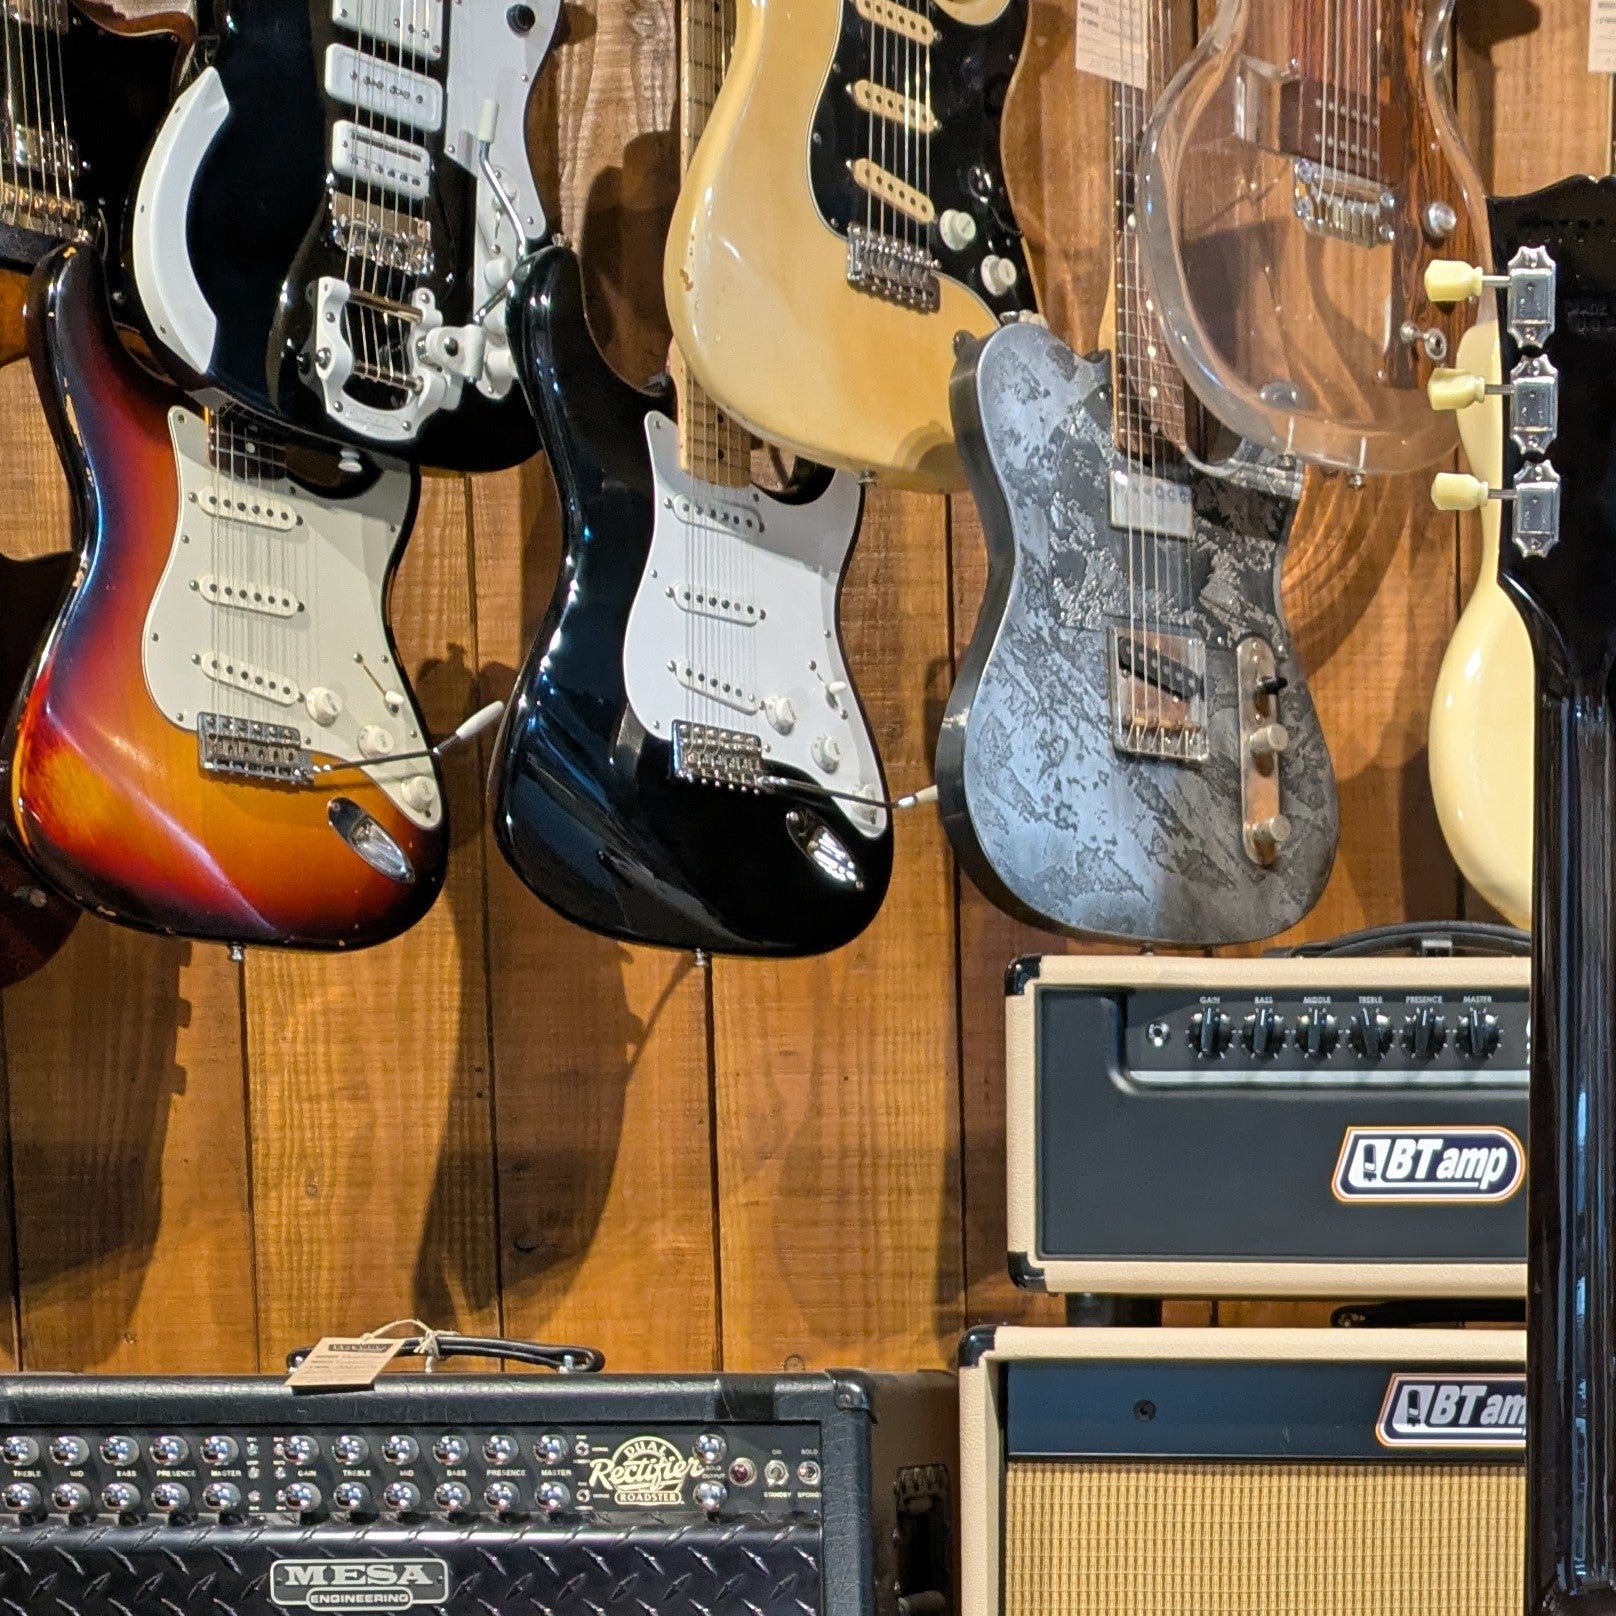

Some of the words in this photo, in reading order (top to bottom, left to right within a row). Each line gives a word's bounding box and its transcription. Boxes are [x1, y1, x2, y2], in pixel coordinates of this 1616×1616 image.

[1254, 996, 1273, 1004] BASS
[1303, 996, 1331, 1004] MIDDLE
[1358, 996, 1383, 1004] TREBLE
[1405, 996, 1443, 1004] PRESENCE
[1479, 1394, 1526, 1436] am
[623, 1441, 667, 1458] DUAL
[156, 1470, 197, 1478] PRESENCE
[210, 1470, 242, 1478] MASTER
[343, 1470, 371, 1478] TREBLE
[486, 1470, 526, 1478] PRESENCE
[541, 1469, 572, 1477] MASTER
[588, 1457, 706, 1492] Rectifier
[620, 1493, 677, 1502] ROADSTER
[284, 1564, 433, 1586] MESA
[310, 1594, 409, 1604] ENGINEERING
